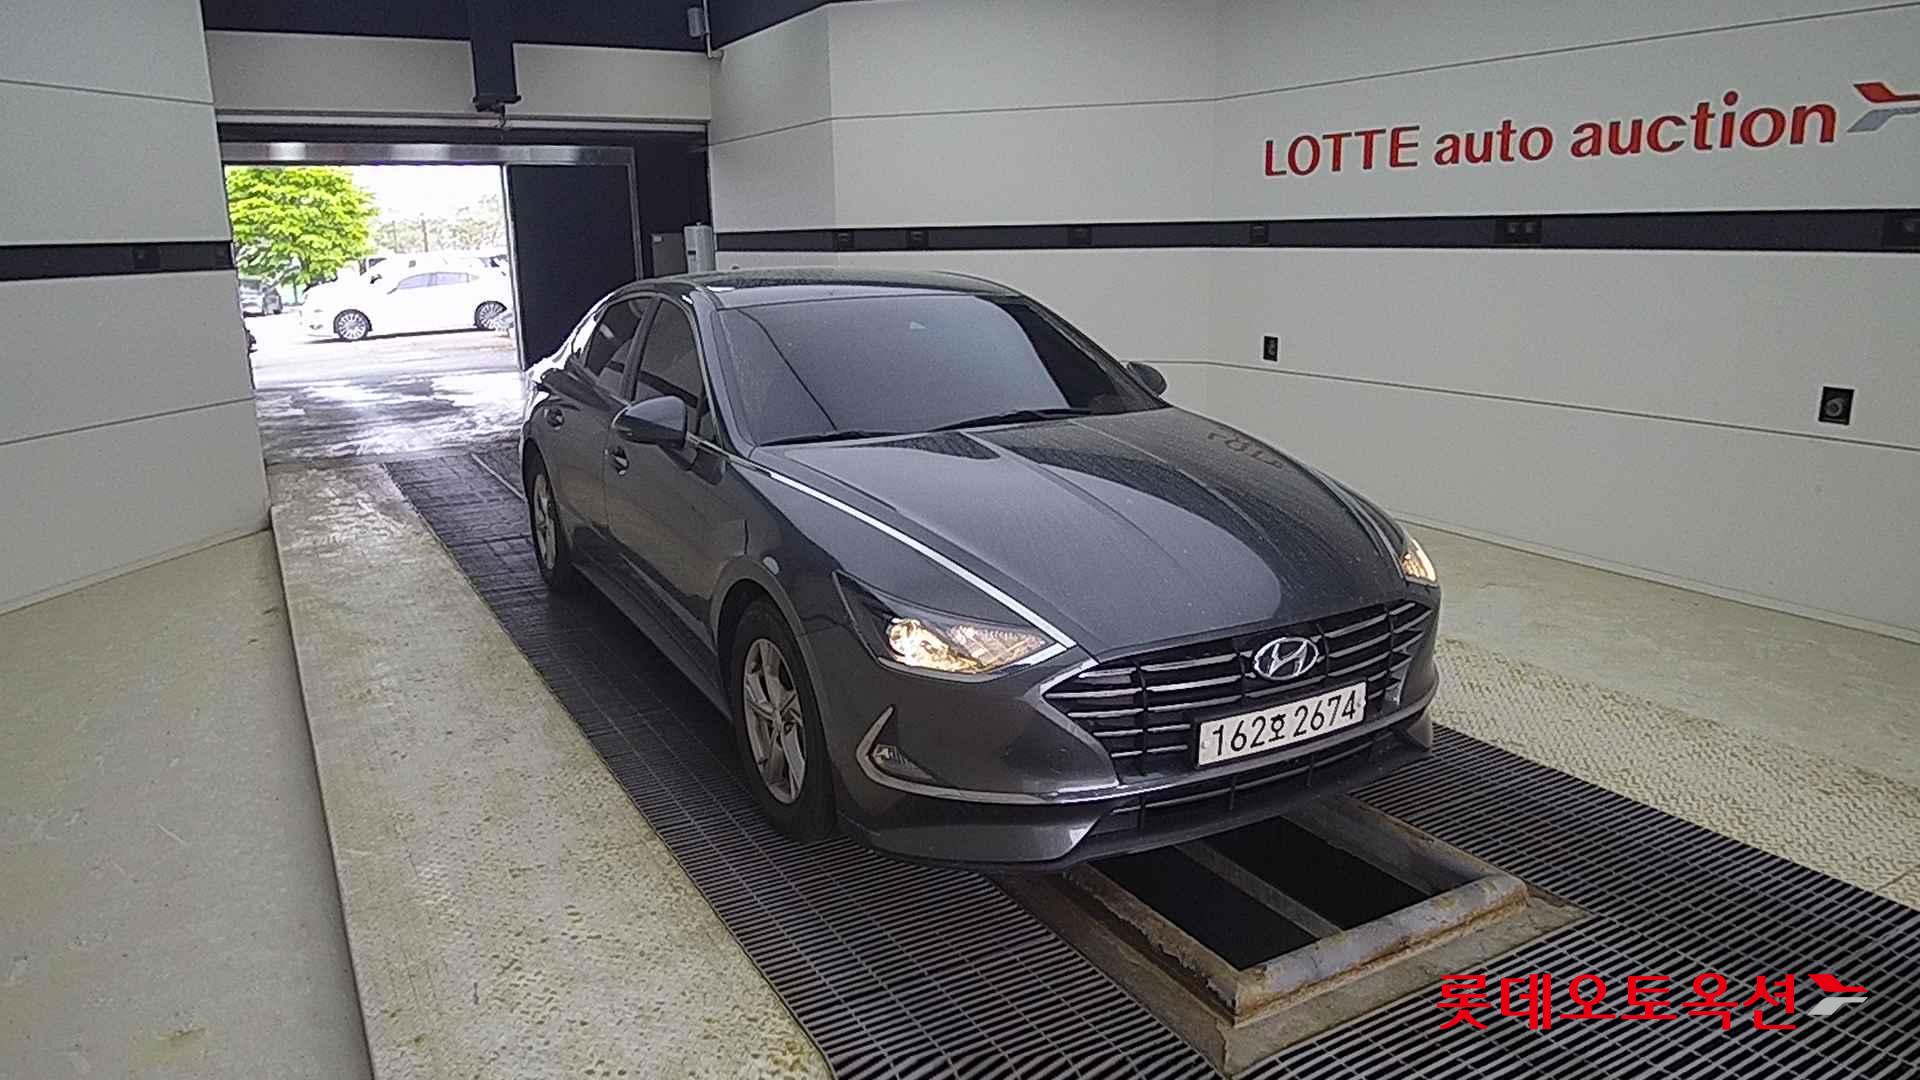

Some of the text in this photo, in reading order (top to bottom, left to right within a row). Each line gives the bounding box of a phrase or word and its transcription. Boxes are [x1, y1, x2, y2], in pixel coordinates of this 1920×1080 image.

[1264, 90, 1838, 177] LOTTE auto auction
[1212, 689, 1357, 756] 162호 2674
